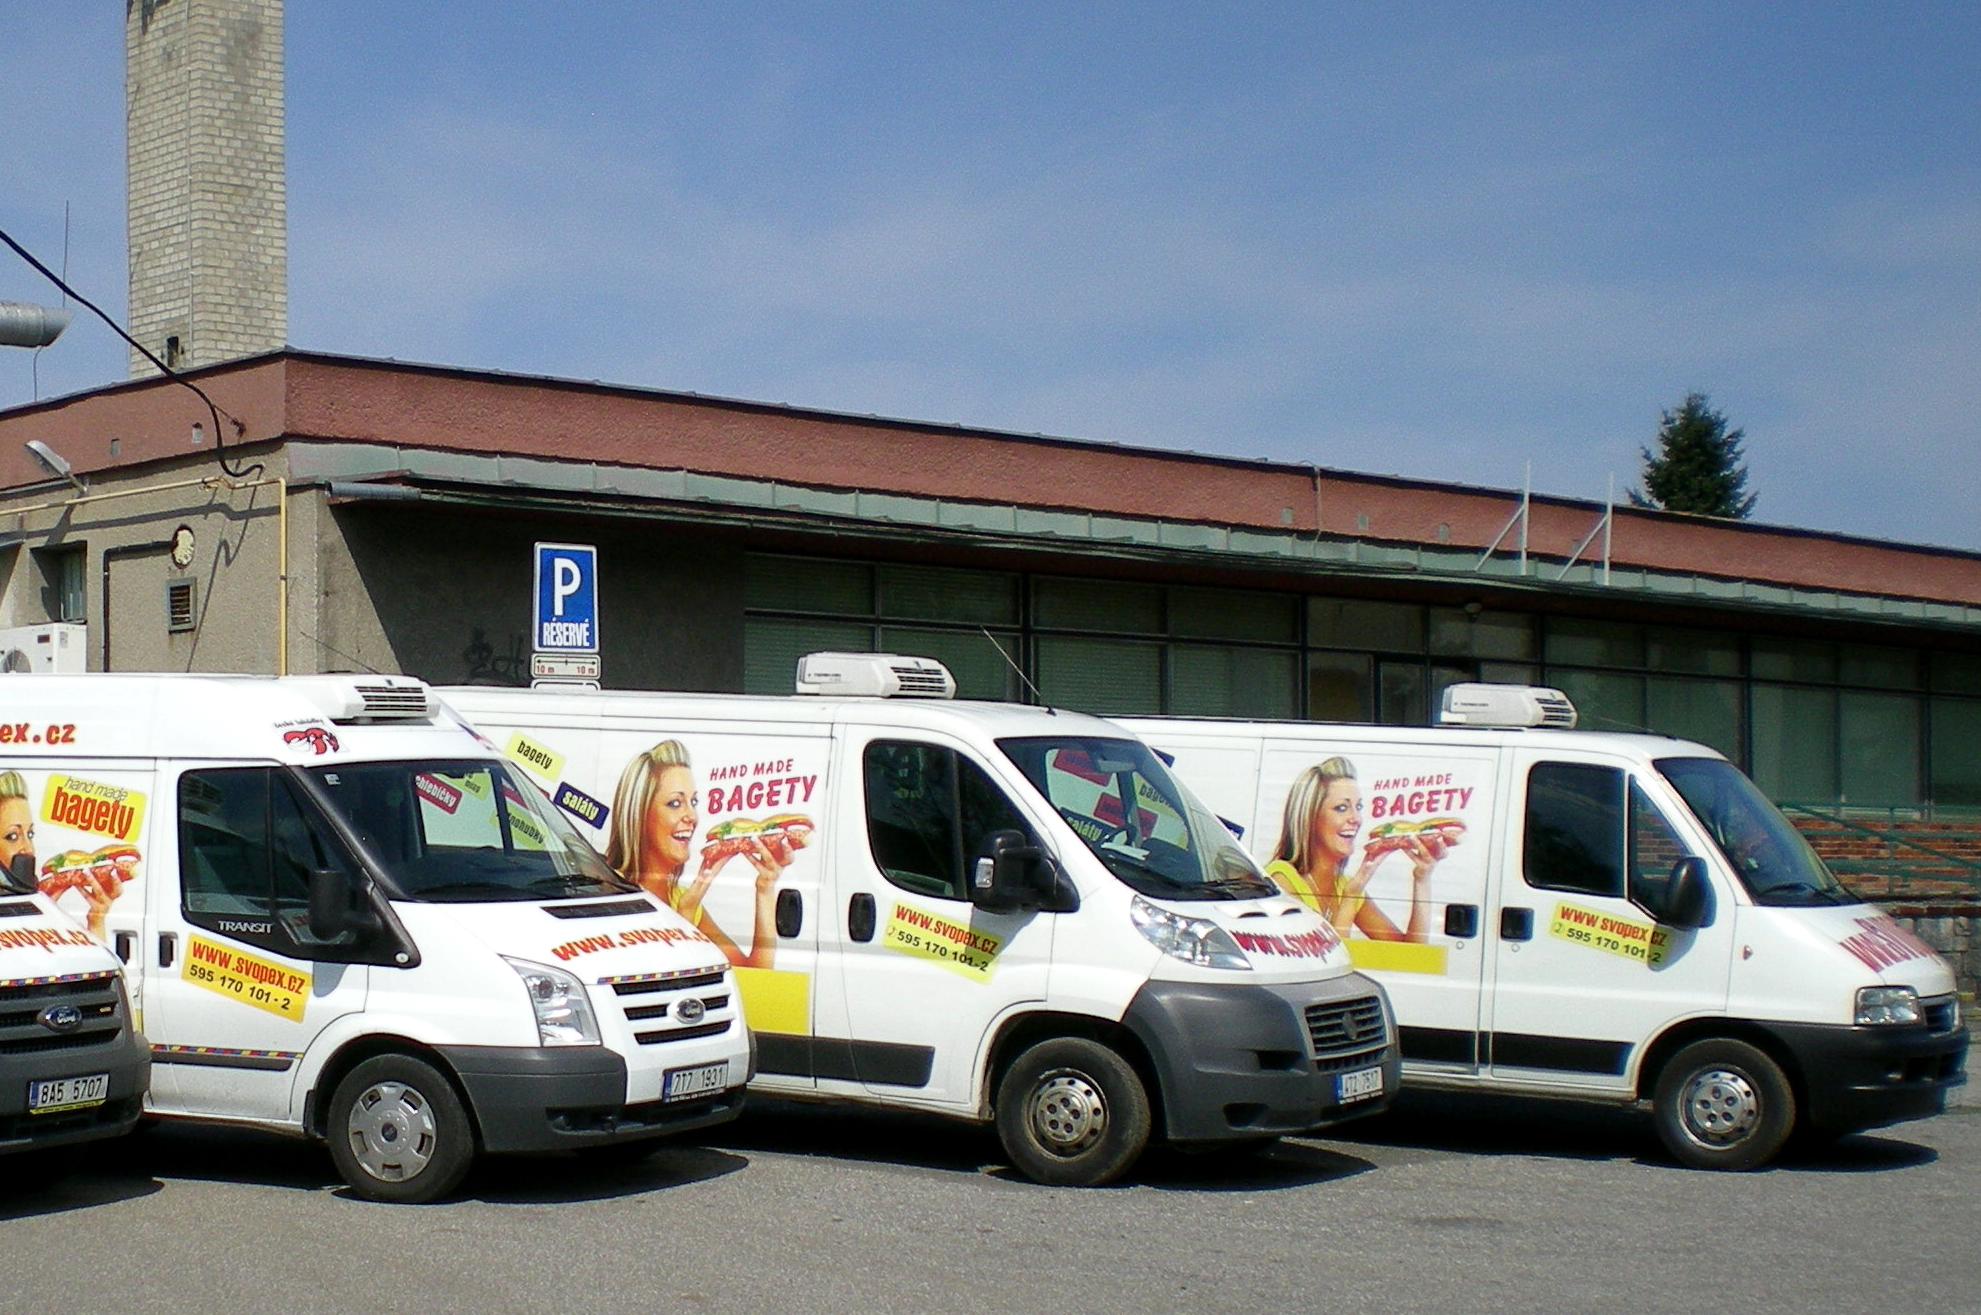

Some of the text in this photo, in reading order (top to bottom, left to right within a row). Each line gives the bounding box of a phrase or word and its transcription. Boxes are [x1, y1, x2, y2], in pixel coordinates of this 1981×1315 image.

[553, 557, 581, 616] P
[543, 617, 590, 647] RÉSERVÉ
[536, 665, 545, 673] 10
[577, 666, 586, 674] 10
[516, 740, 553, 770] bagety
[710, 758, 794, 781] HAND MADE
[64, 776, 128, 801] hand made
[708, 775, 817, 815] BAGETY
[1374, 773, 1453, 790] HAND MADE
[51, 786, 135, 840] bagety
[562, 790, 600, 821] saláty
[1372, 787, 1474, 818] BAGETY
[218, 920, 274, 934] TRANSIT
[895, 904, 998, 956] www.svopex.cz
[1567, 928, 1592, 943] 595
[1595, 936, 1619, 951] 170
[897, 931, 922, 948] 595
[925, 942, 948, 957] 170
[190, 964, 215, 982] 595
[220, 975, 243, 993] 170
[192, 941, 306, 995] www.svopex.cz
[41, 1078, 102, 1103] 8A5 5707
[674, 1066, 724, 1093] 7T7 1931
